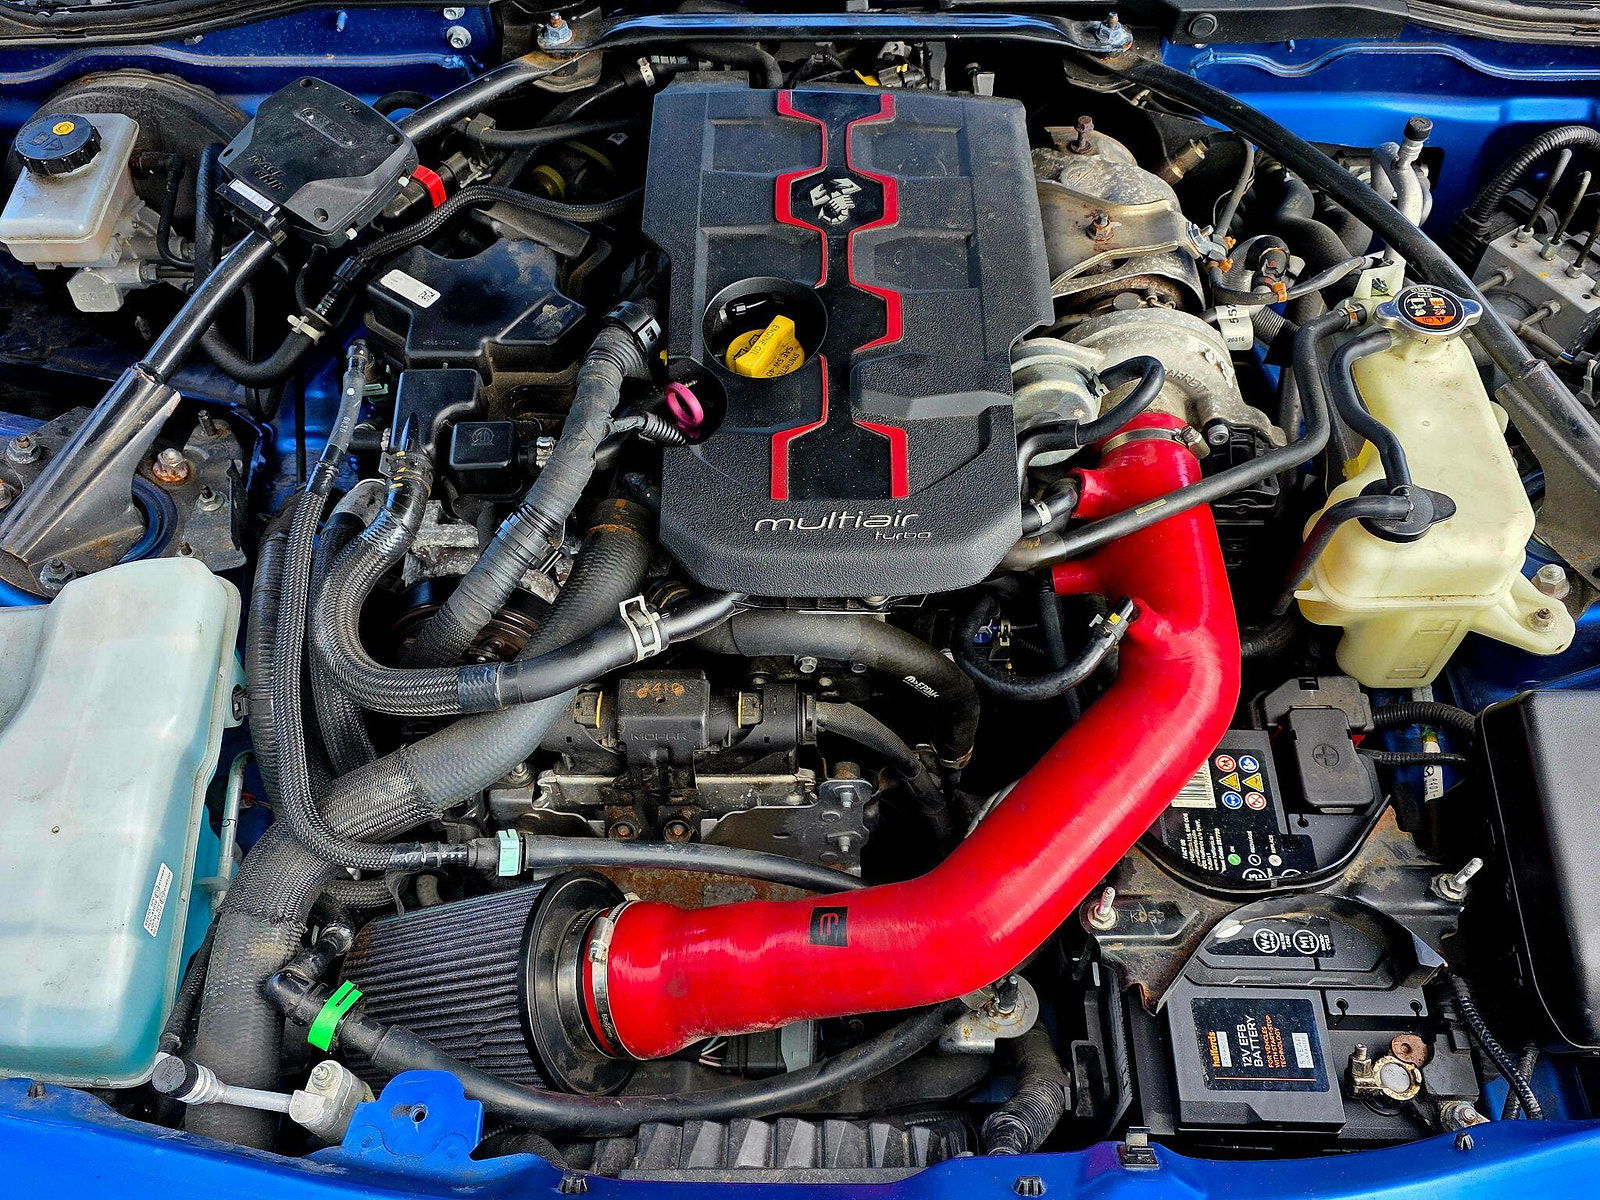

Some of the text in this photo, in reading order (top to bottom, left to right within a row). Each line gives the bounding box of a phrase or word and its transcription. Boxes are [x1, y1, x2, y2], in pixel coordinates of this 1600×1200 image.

[749, 324, 780, 356] ENGINE OIL
[765, 345, 794, 377] SAE 5W-40
[1165, 368, 1209, 393] ARRETT
[754, 510, 919, 532] multiair
[874, 530, 931, 540] turbo
[1259, 932, 1271, 950] W4
[1298, 935, 1310, 949] M1
[1207, 1031, 1221, 1068] halfords
[1236, 1023, 1252, 1067] 12V EFB
[1244, 1015, 1264, 1067] BATTERY
[1260, 1026, 1275, 1068] FOR VEHICLES
[1265, 1014, 1280, 1068] WITH START-STOP
[1274, 1027, 1287, 1068] TECHNOLOGY
[1294, 1036, 1305, 1058] YEAR
